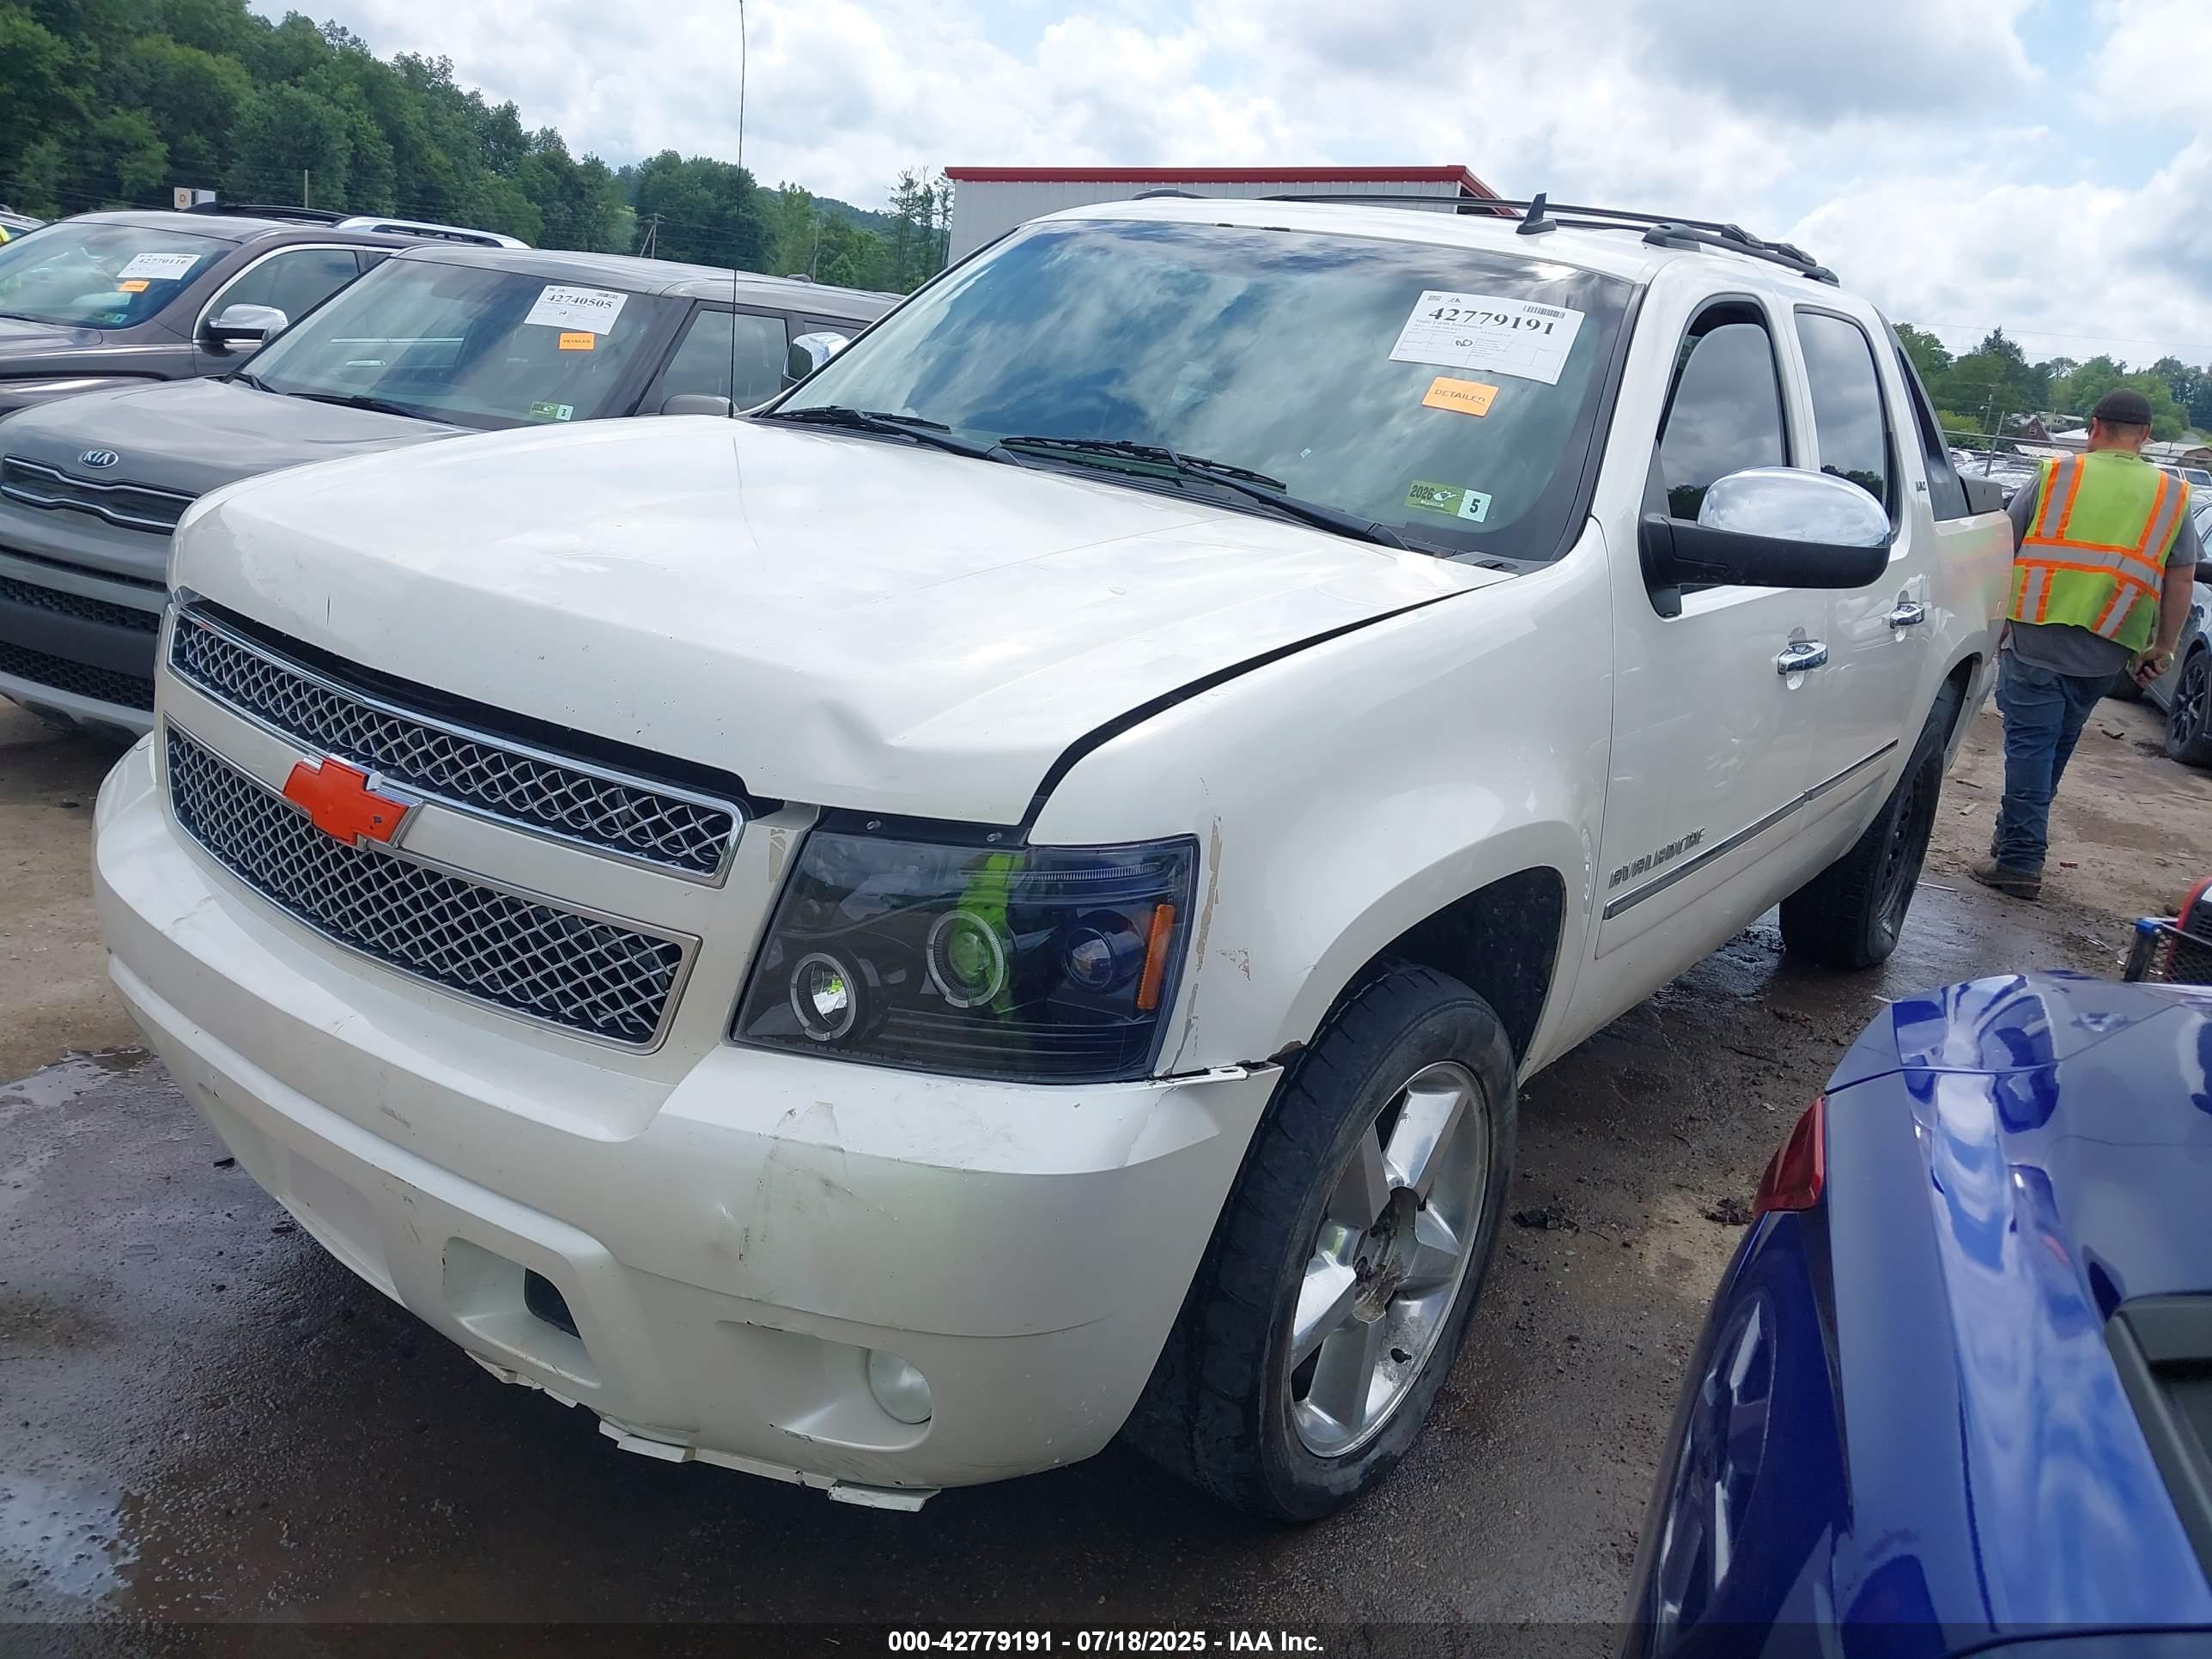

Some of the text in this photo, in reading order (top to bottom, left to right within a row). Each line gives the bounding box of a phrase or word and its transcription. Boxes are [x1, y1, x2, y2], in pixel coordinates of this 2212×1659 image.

[179, 193, 186, 203] D
[547, 294, 614, 309] 42740505
[1428, 307, 1556, 336] 42779191
[561, 408, 568, 416] 3
[83, 450, 111, 465] KIA
[1410, 484, 1435, 501] 2026
[1469, 498, 1481, 514] 5
